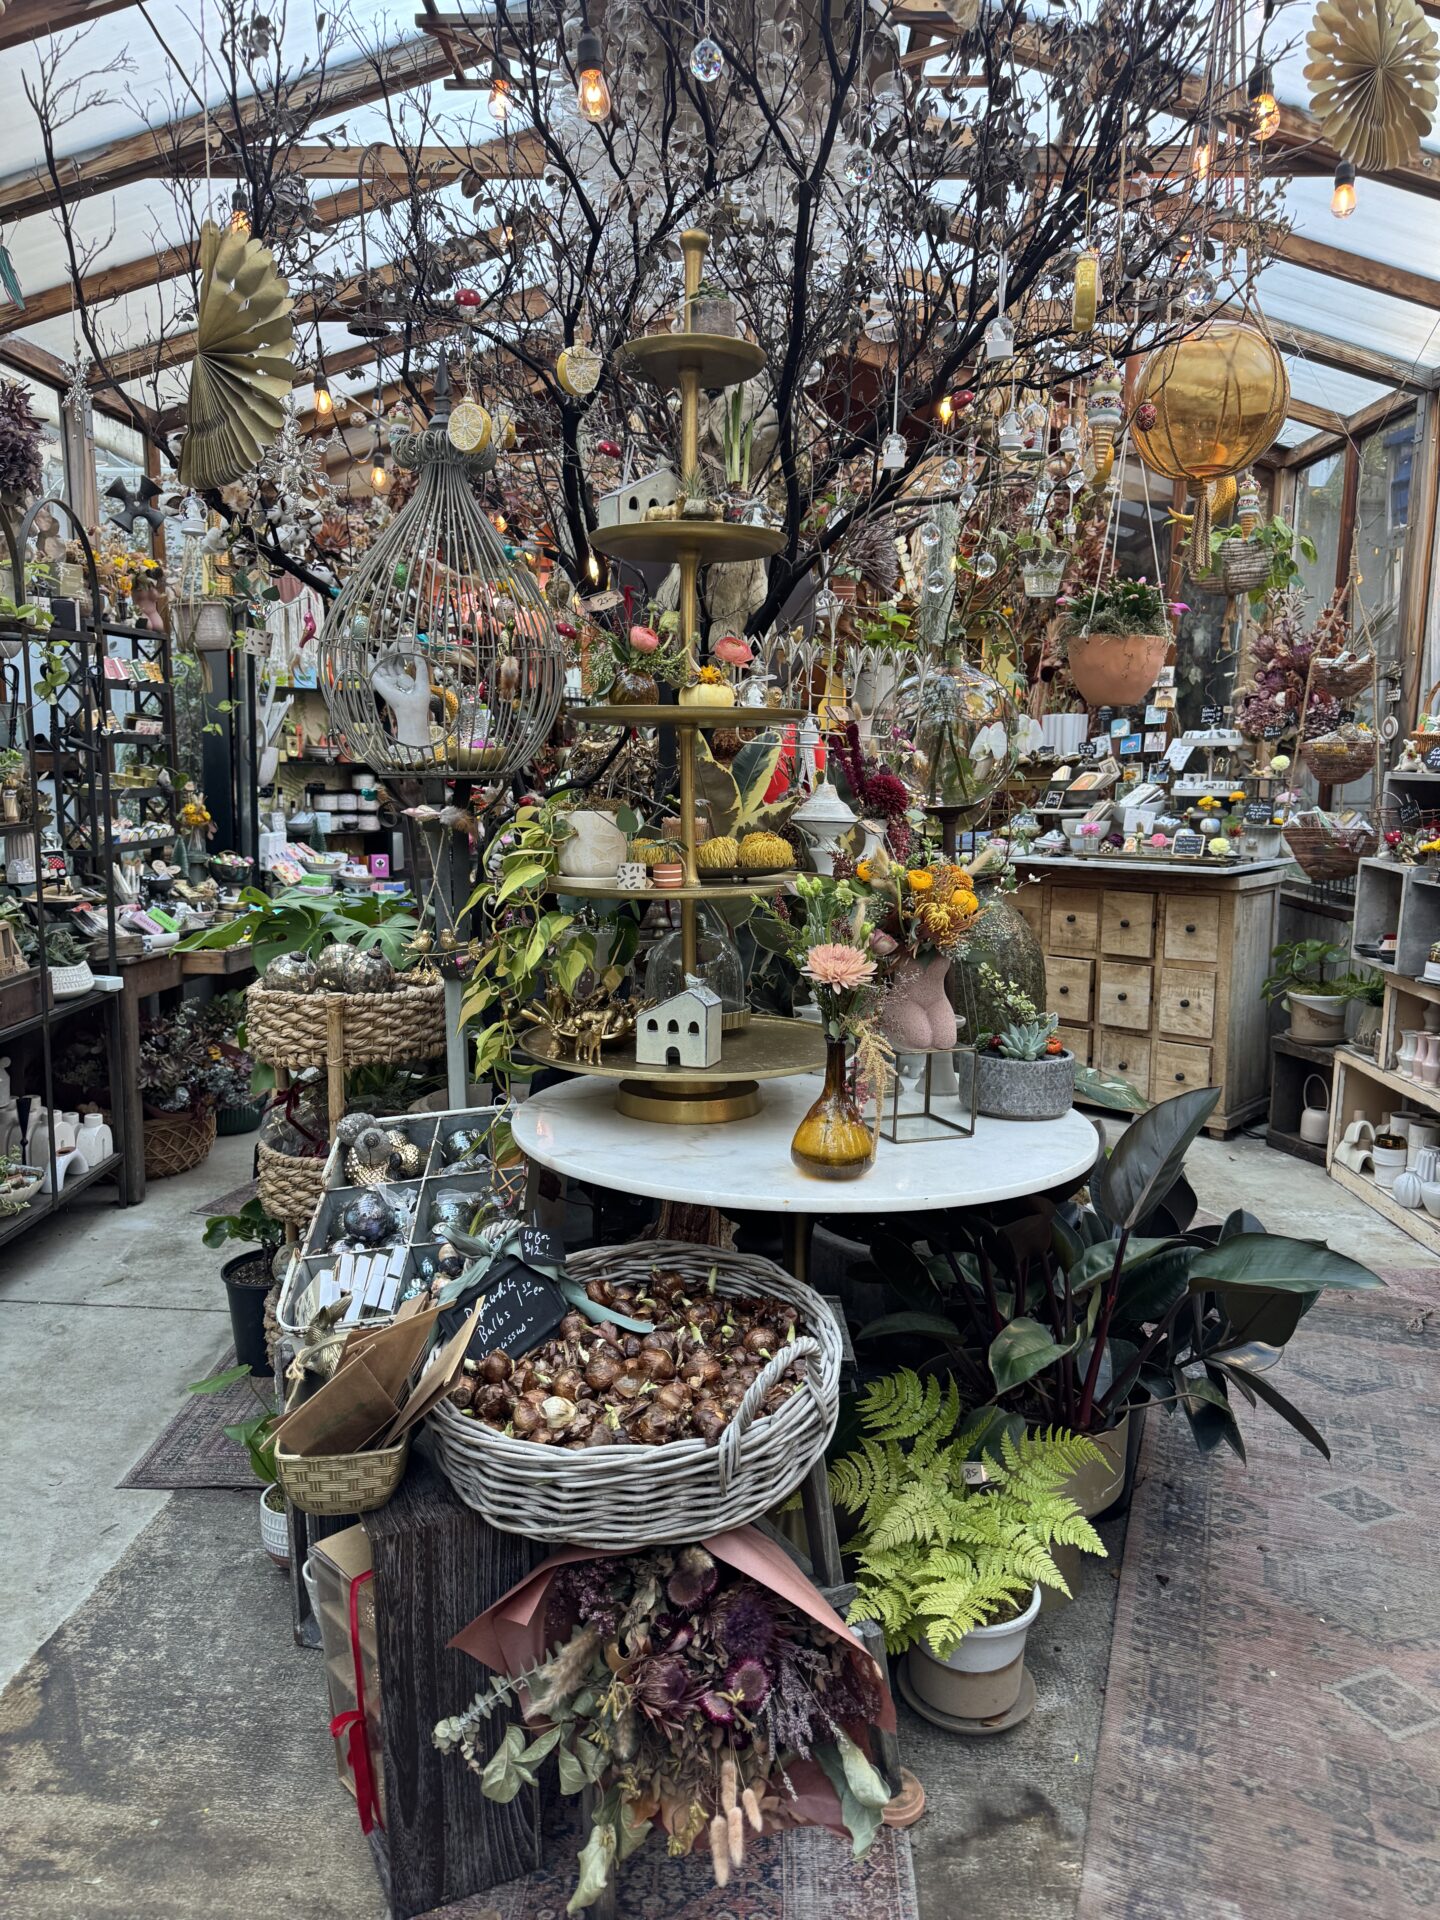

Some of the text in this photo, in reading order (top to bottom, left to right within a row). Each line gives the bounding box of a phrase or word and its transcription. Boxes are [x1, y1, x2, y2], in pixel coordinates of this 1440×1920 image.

[524, 1230, 551, 1245] 10 for
[477, 1310, 511, 1345] Bulbs
